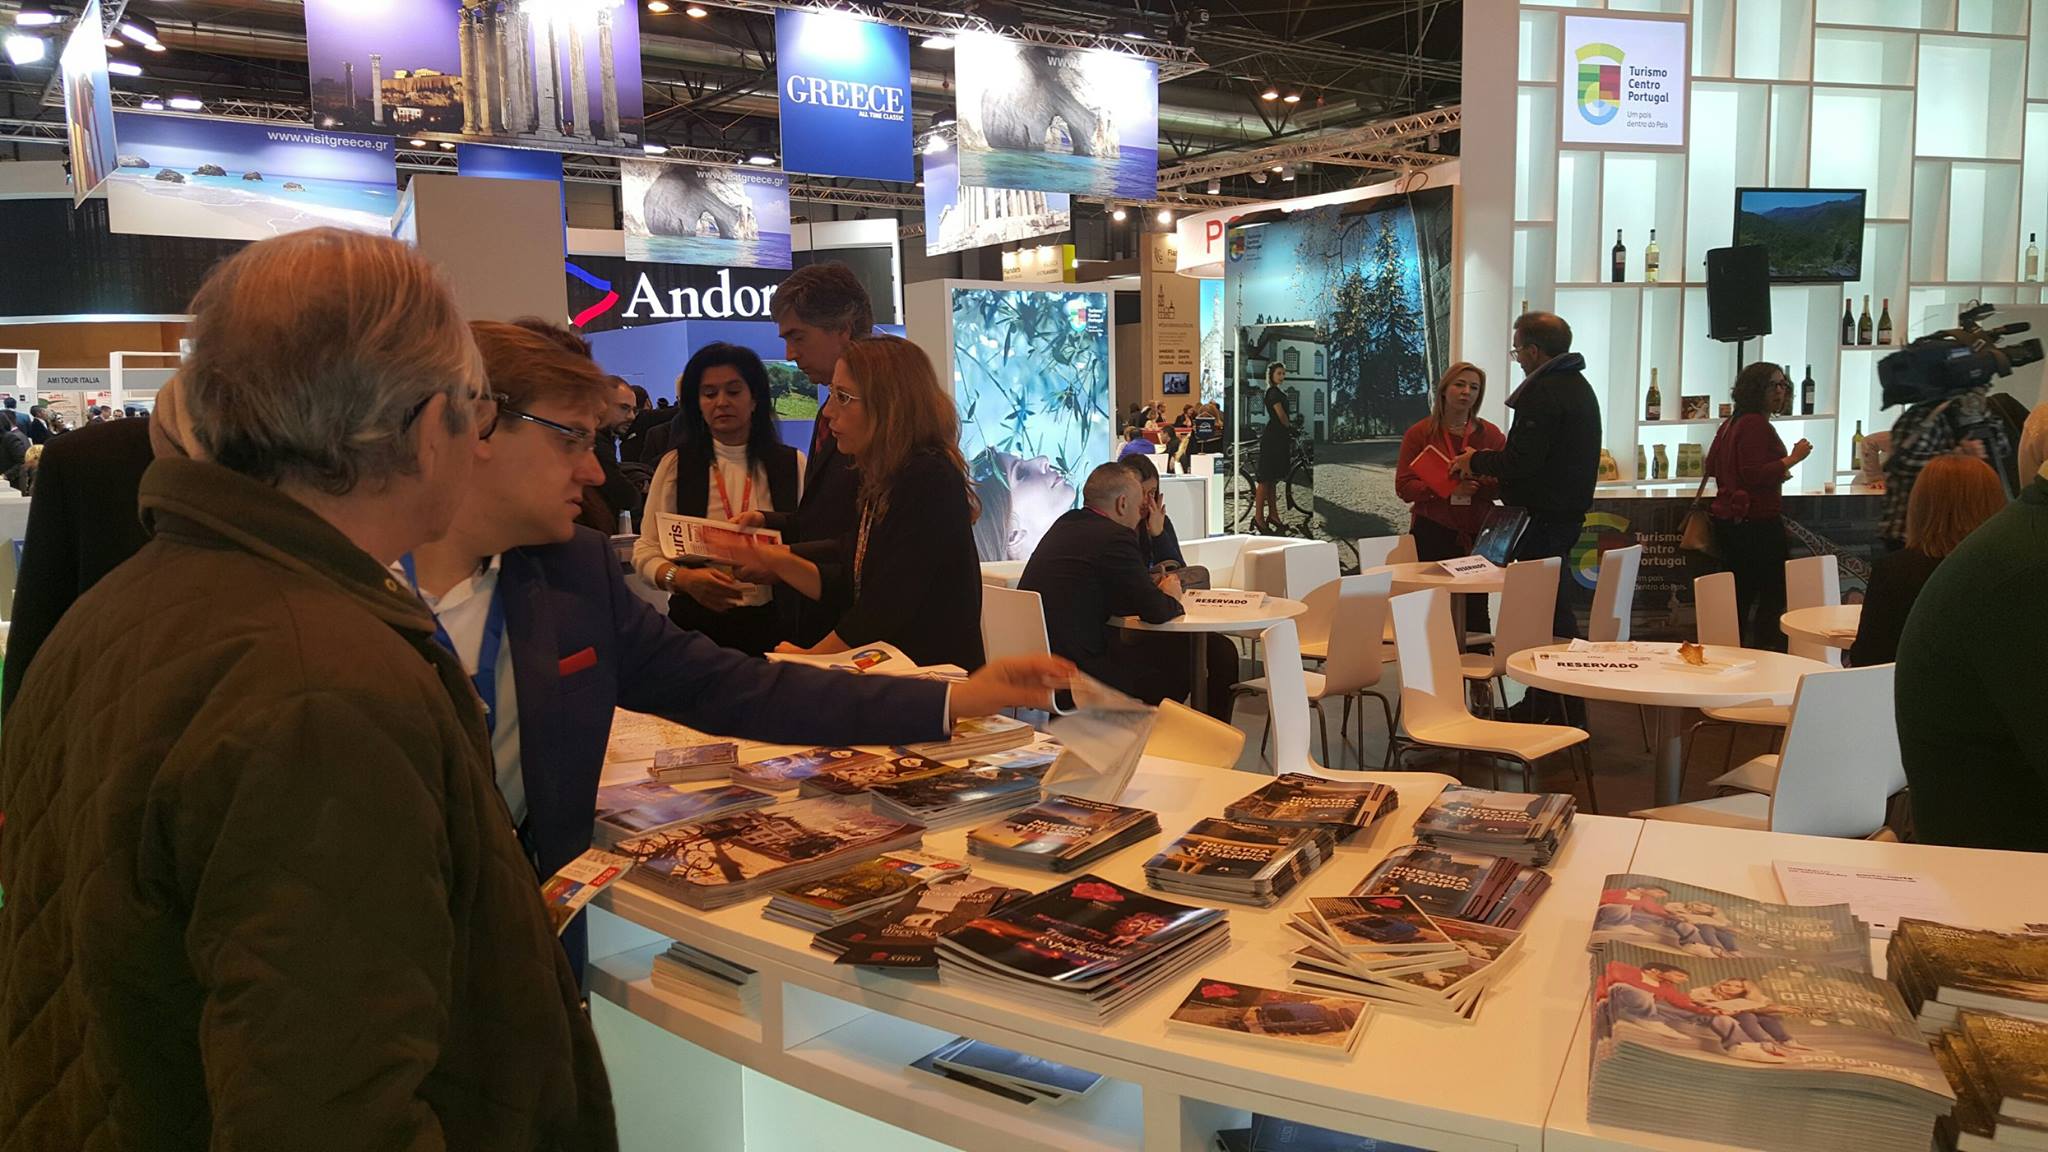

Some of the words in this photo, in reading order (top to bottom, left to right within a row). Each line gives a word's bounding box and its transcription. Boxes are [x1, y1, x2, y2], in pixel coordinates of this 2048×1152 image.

[1629, 66, 1668, 78] Turismo
[1628, 79, 1661, 89] Centro
[787, 75, 904, 114] GREECE
[1628, 91, 1669, 104] Portugal
[267, 131, 388, 152] www.visitgreece.gr
[621, 268, 778, 318] Andor
[1634, 532, 1685, 542] Turismo
[1641, 546, 1676, 554] entro
[1640, 555, 1687, 568] ortugal
[1557, 661, 1639, 669] RESERVADO
[1201, 841, 1270, 854] NUESTRA
[1392, 866, 1470, 882] NUESTRA
[1780, 992, 1891, 1018] DESTINO
